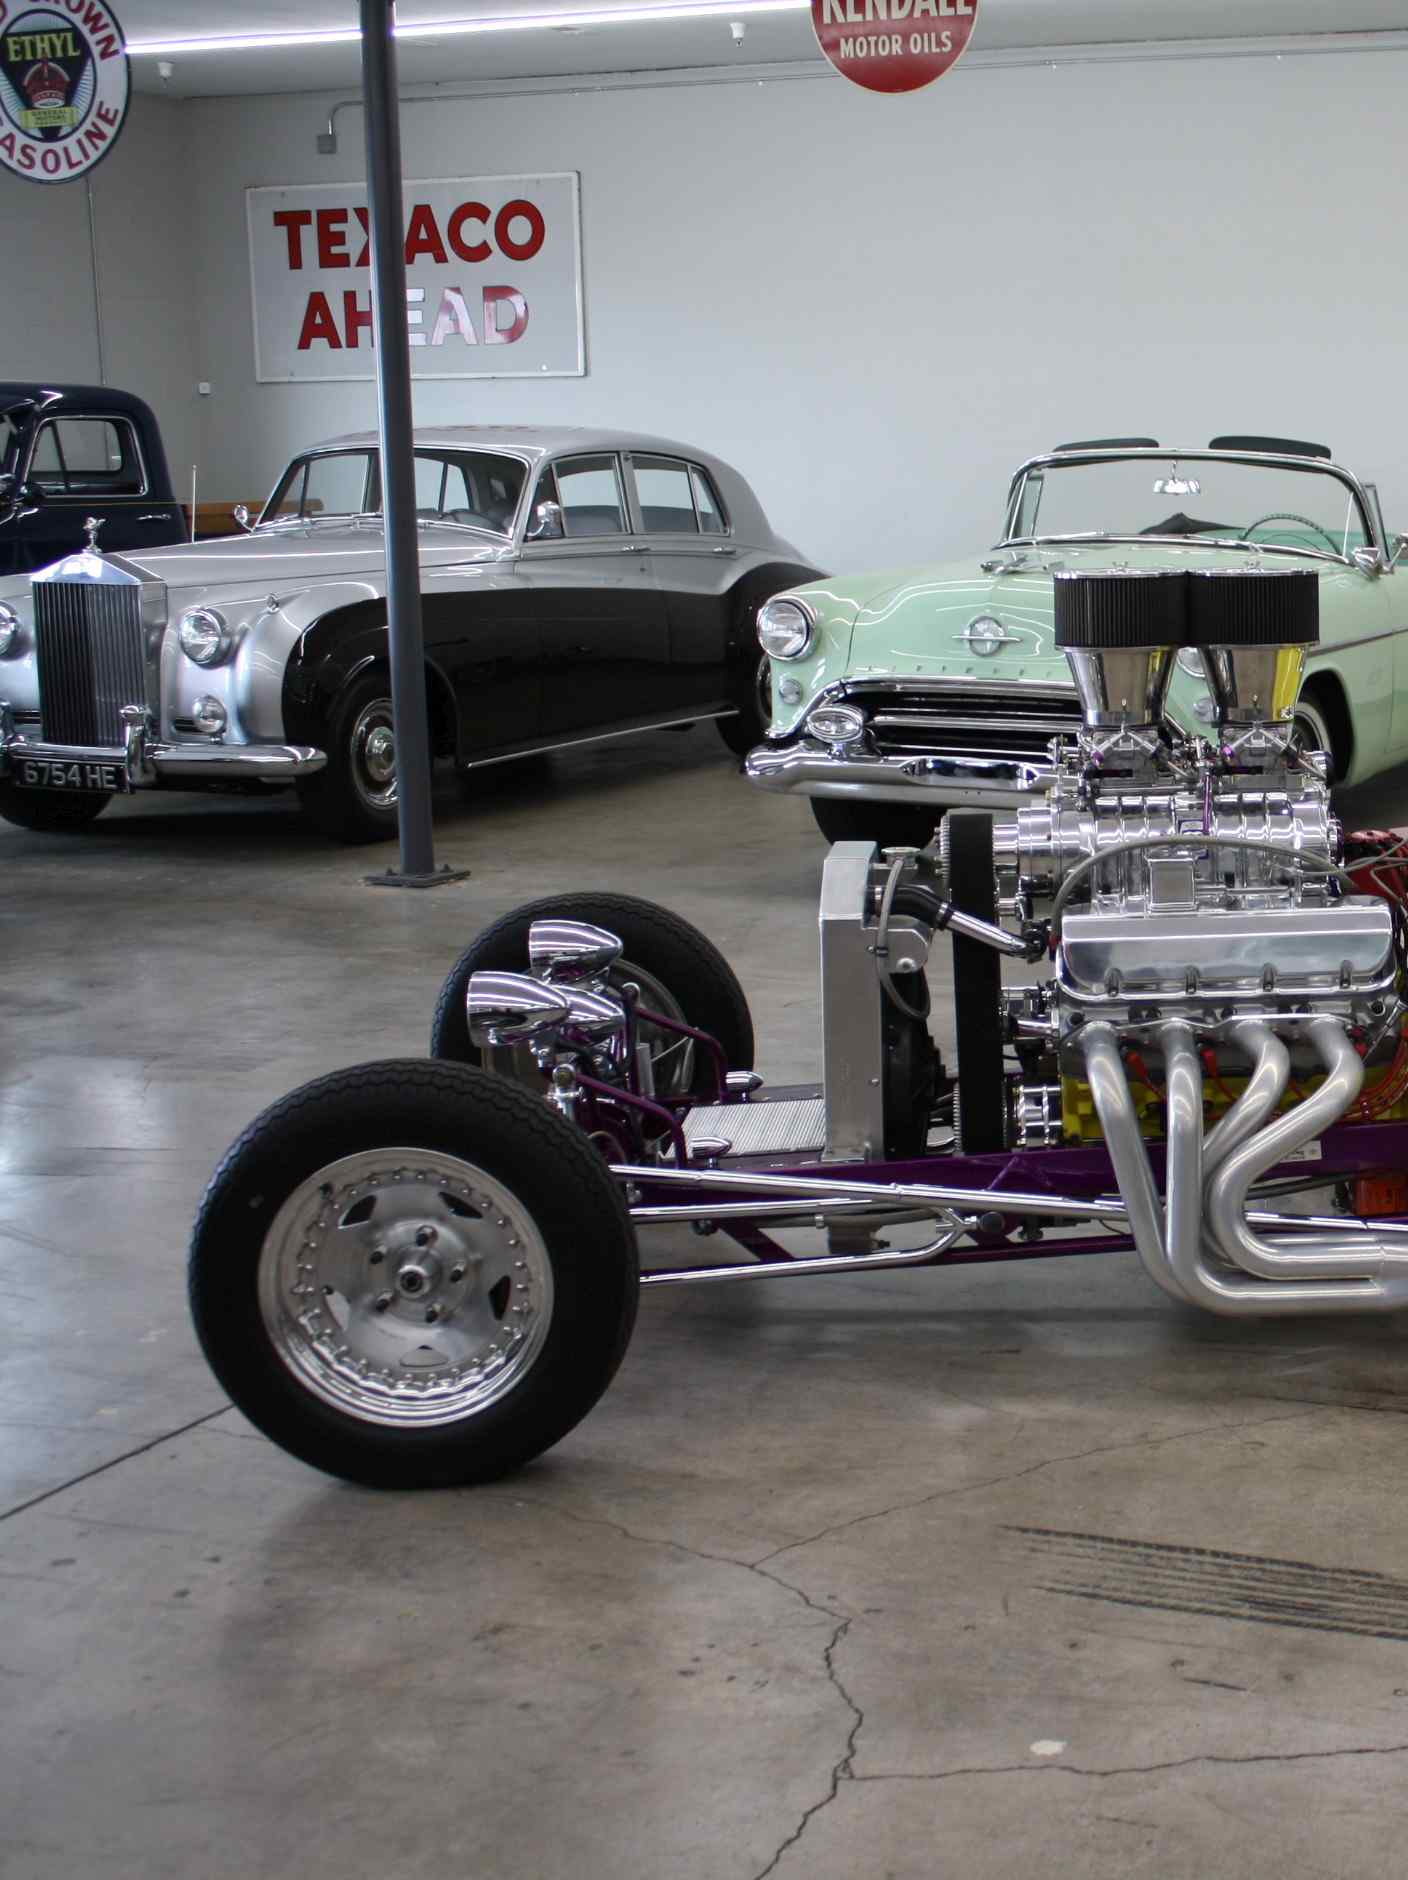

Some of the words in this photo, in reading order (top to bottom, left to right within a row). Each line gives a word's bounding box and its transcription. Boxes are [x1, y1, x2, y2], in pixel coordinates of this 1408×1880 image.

[6, 32, 81, 62] ETHYL
[29, 0, 121, 61] OWN
[840, 34, 903, 58] MOTOR
[909, 31, 952, 54] OILS
[0, 101, 119, 174] ASOLINE
[297, 285, 529, 350] AHEAD
[23, 760, 82, 788] 6754
[85, 765, 117, 790] HE
